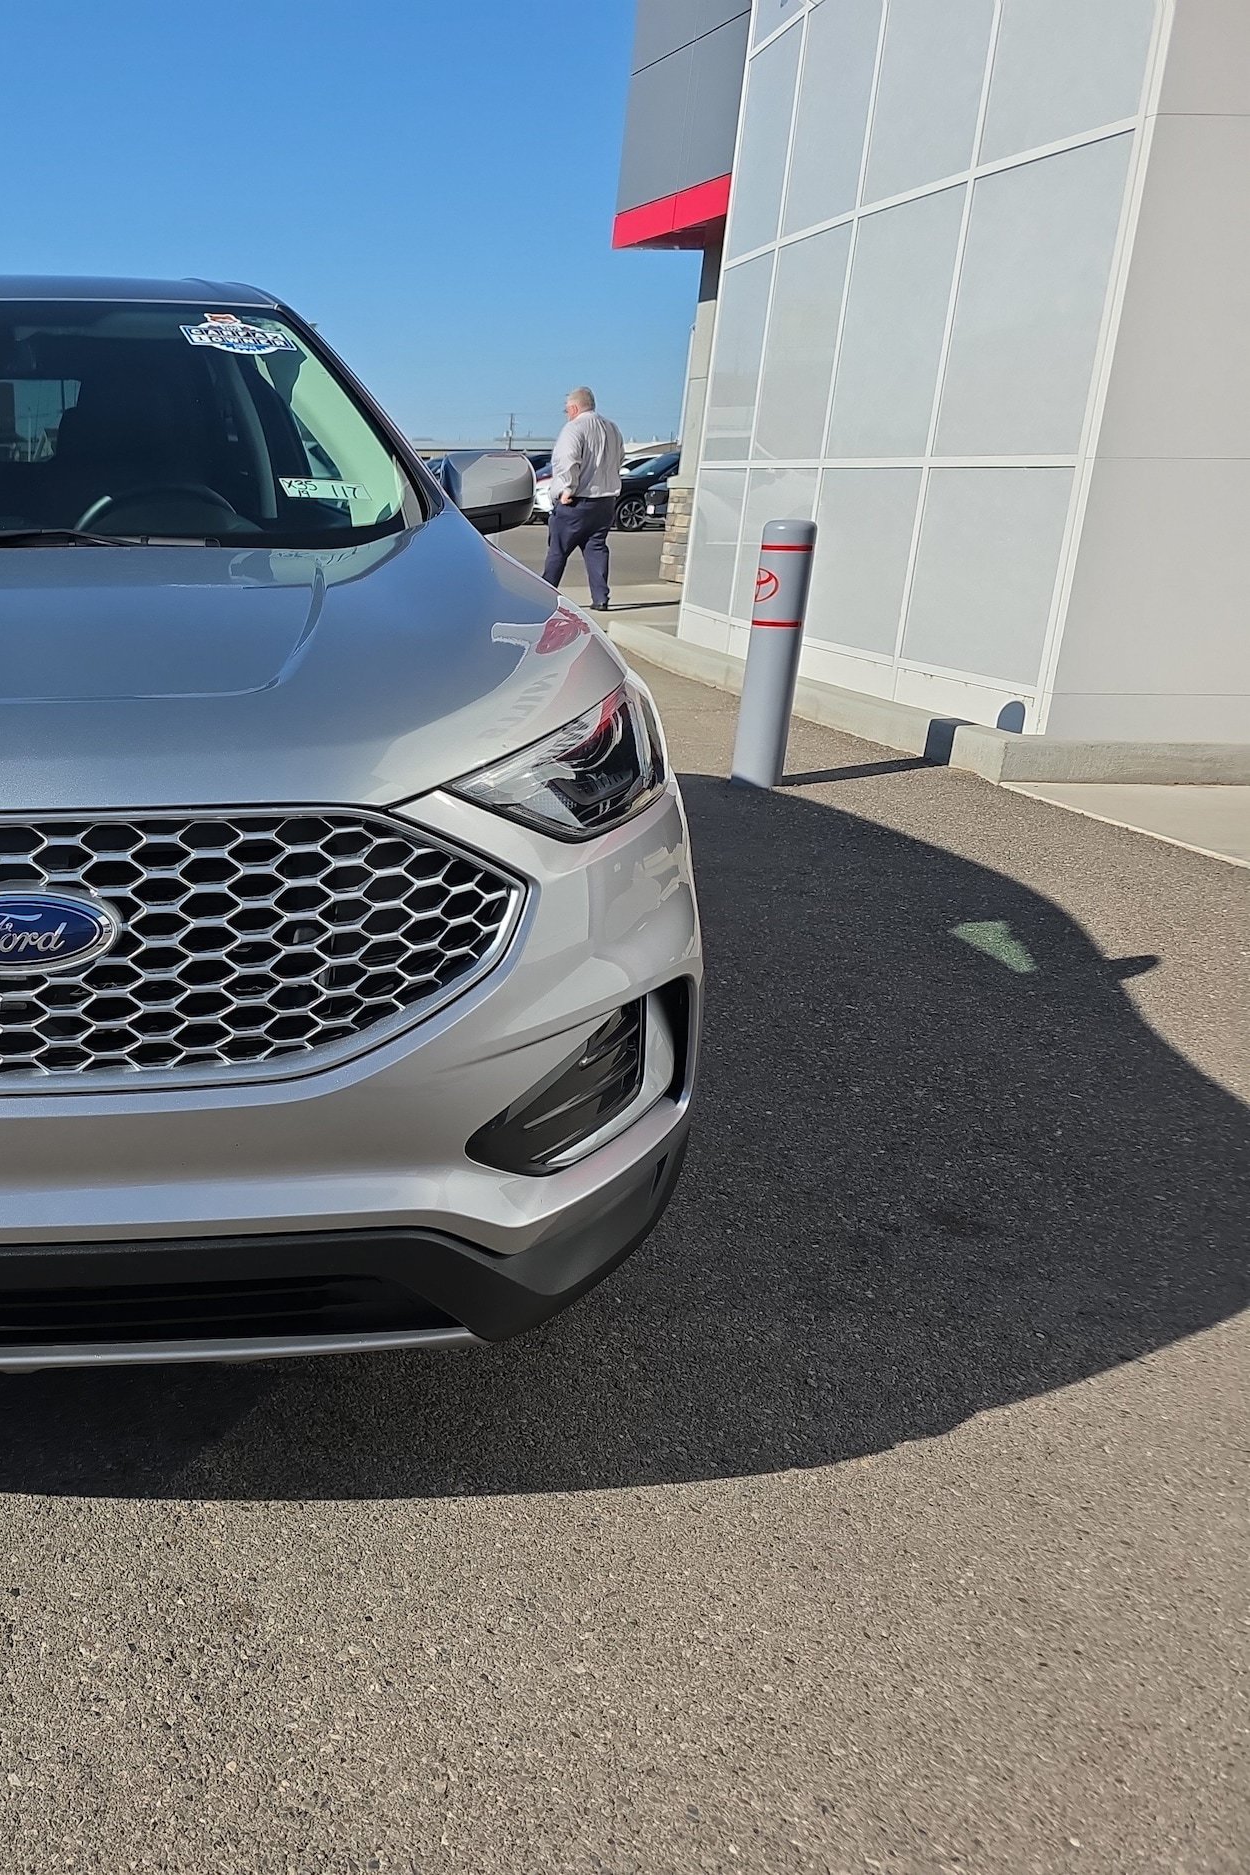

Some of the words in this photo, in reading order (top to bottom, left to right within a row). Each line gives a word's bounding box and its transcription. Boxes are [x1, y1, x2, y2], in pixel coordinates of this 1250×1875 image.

[190, 328, 285, 340] CARFAX
[211, 336, 287, 347] OWNER
[281, 480, 318, 491] X35
[332, 484, 359, 499] 117
